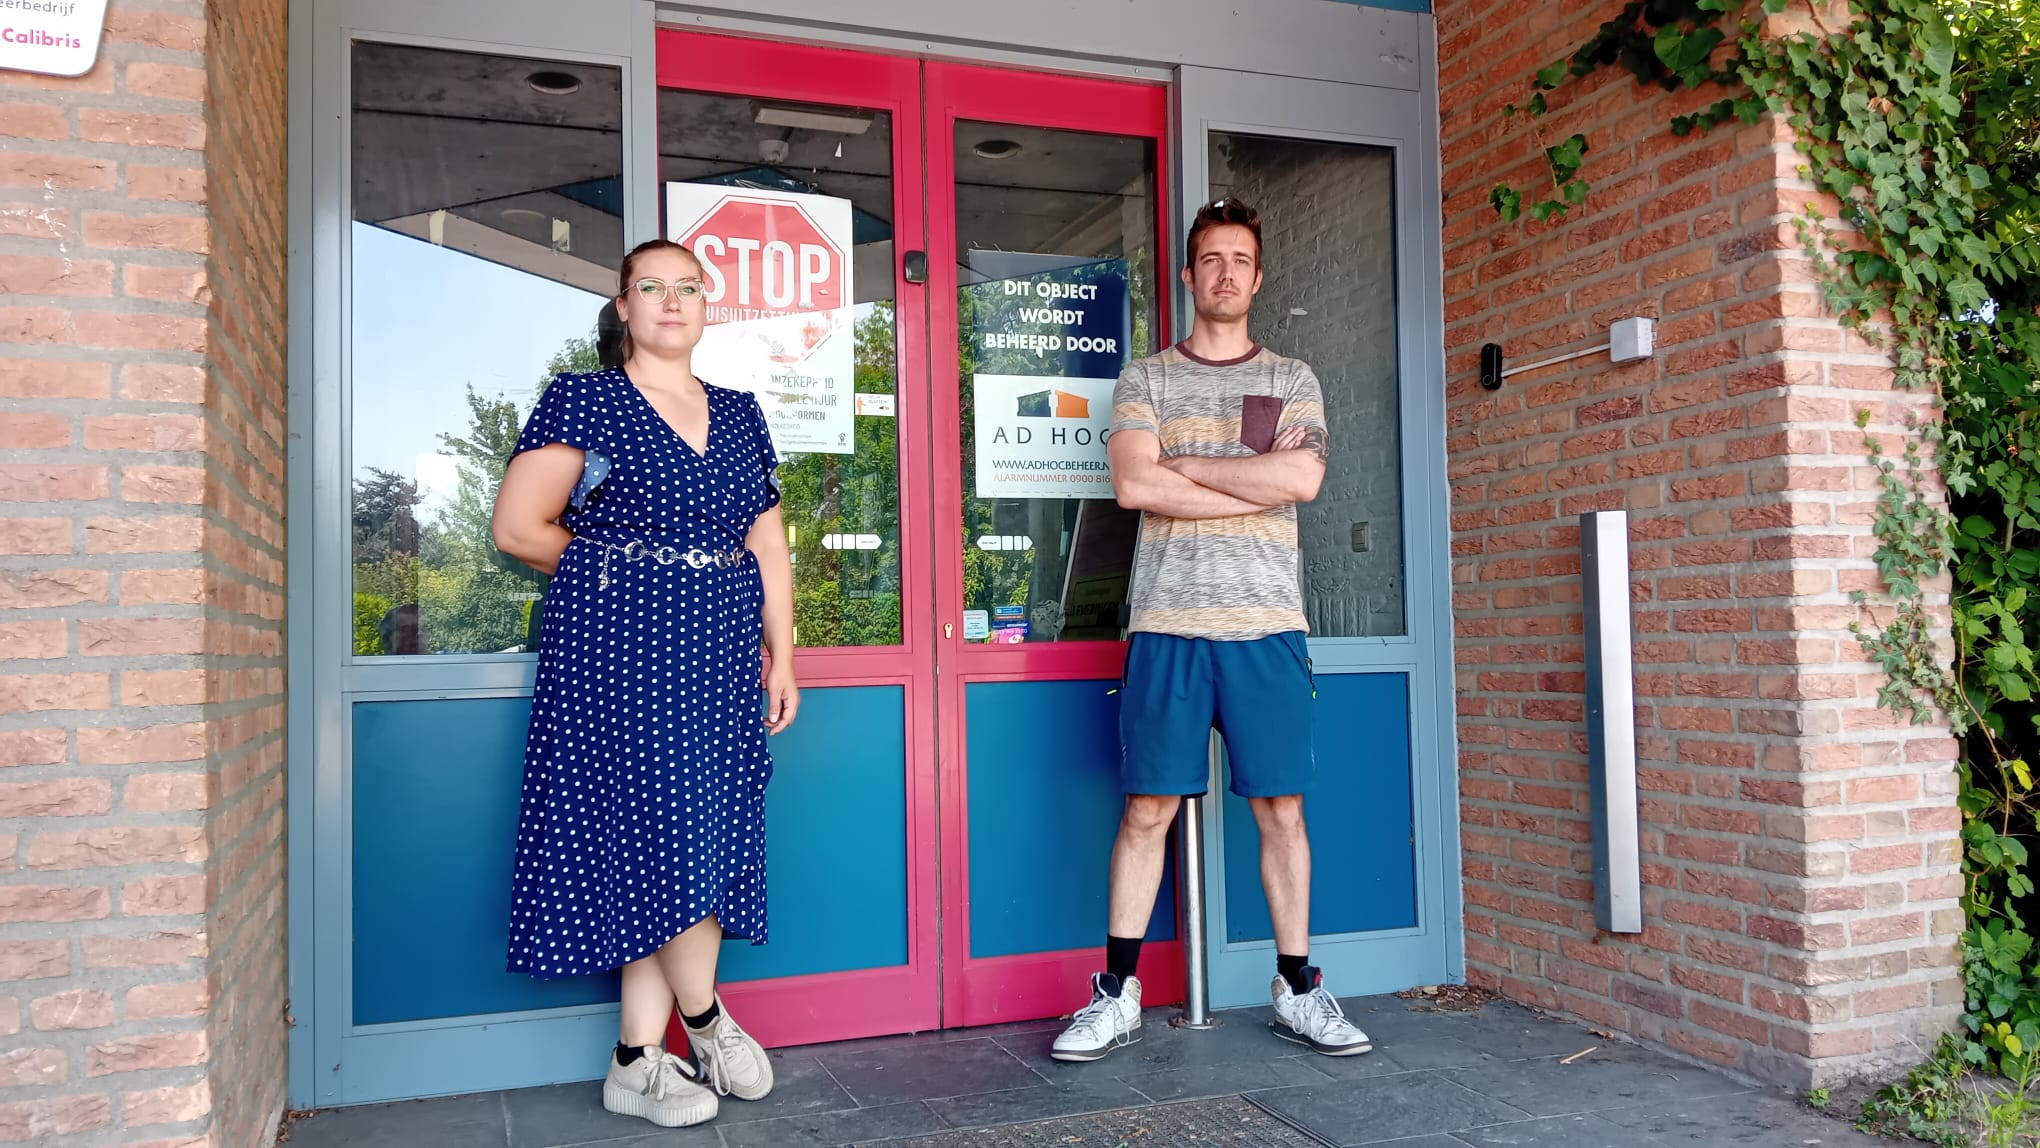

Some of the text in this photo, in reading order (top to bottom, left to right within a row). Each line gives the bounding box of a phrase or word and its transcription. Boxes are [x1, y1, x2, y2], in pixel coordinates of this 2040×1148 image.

[1, 27, 81, 48] Calibris
[693, 234, 831, 308] STOP
[1004, 280, 1097, 300] DIT OBJECT
[1019, 307, 1084, 325] WORDT
[985, 333, 1117, 353] BEHEERD DOOR
[992, 426, 1110, 446] AD HOC
[992, 459, 1110, 471] WWW.ADHOCBEHEER.N
[994, 474, 1067, 483] ALARMNUMMER
[1070, 475, 1093, 483] 0900
